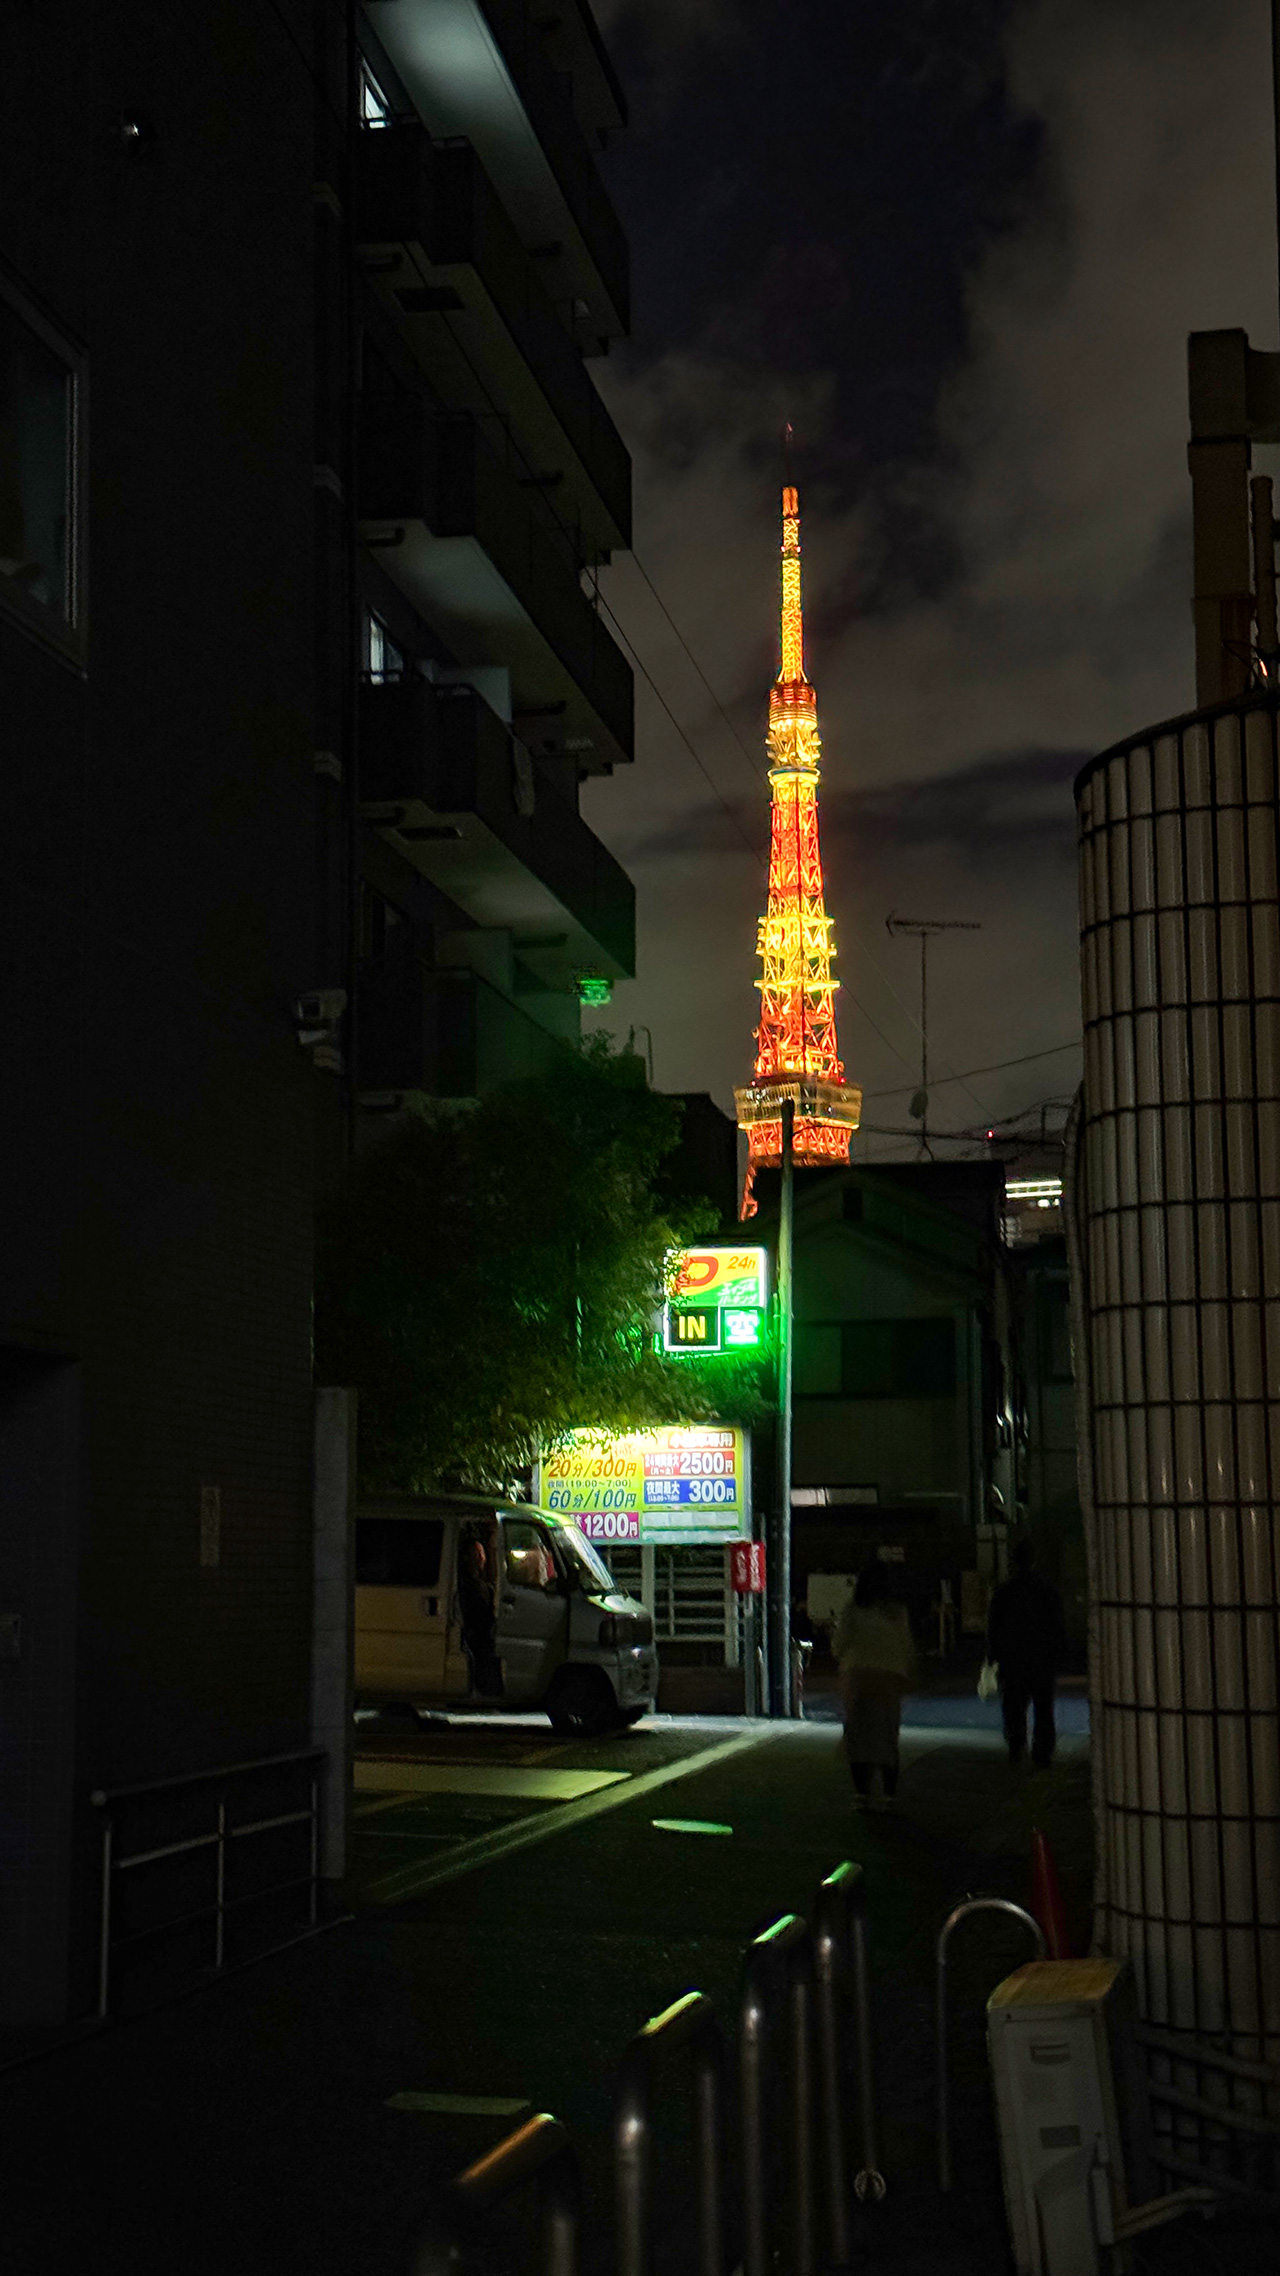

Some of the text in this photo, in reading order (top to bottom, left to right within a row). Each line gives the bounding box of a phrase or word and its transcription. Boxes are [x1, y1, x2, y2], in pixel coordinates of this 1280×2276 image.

[679, 1316, 706, 1339] IN
[726, 1311, 759, 1343] 空
[549, 1489, 637, 1509] 60分/100円
[689, 1480, 734, 1502] 300円
